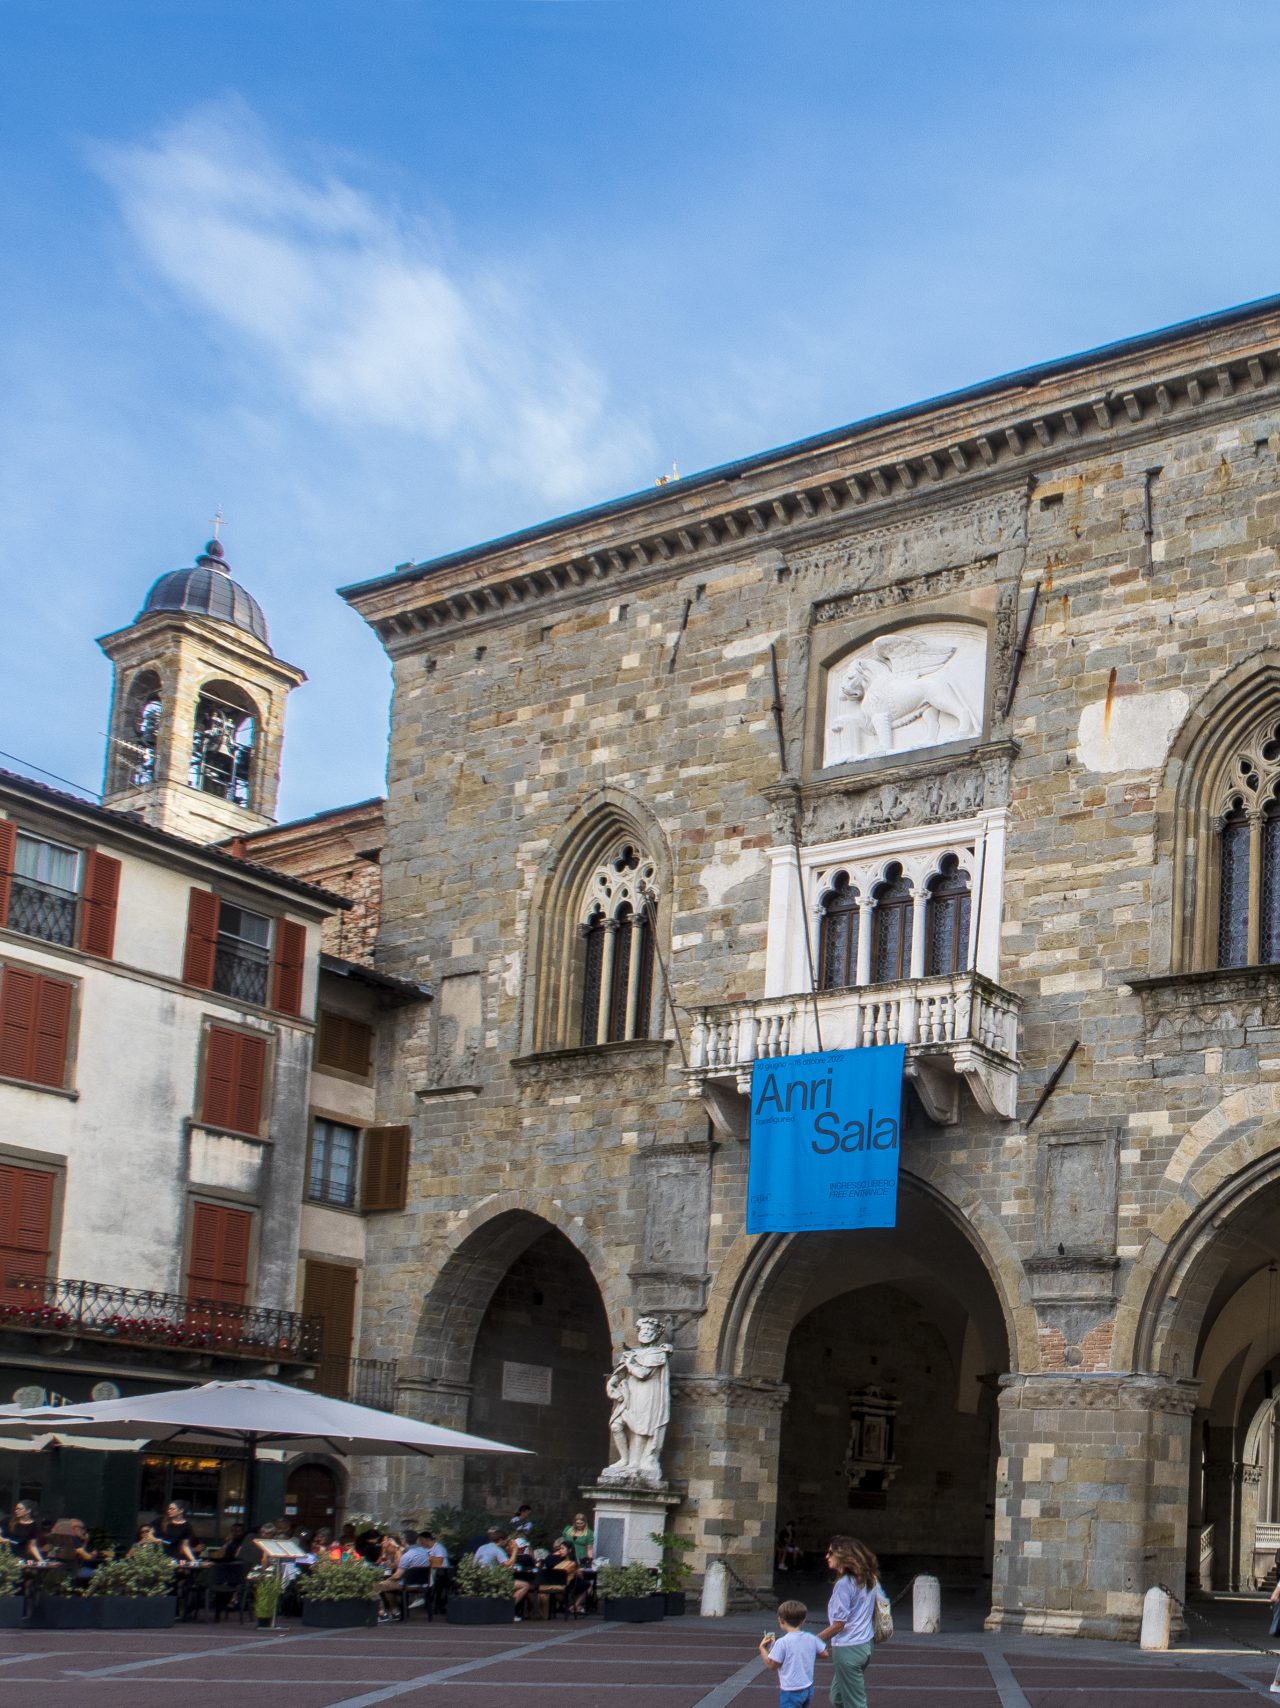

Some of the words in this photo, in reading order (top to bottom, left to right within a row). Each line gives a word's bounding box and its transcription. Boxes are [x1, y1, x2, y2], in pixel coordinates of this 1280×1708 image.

[755, 1067, 833, 1115] Anri
[812, 1109, 897, 1154] Sala
[867, 1178, 896, 1188] LIBERO
